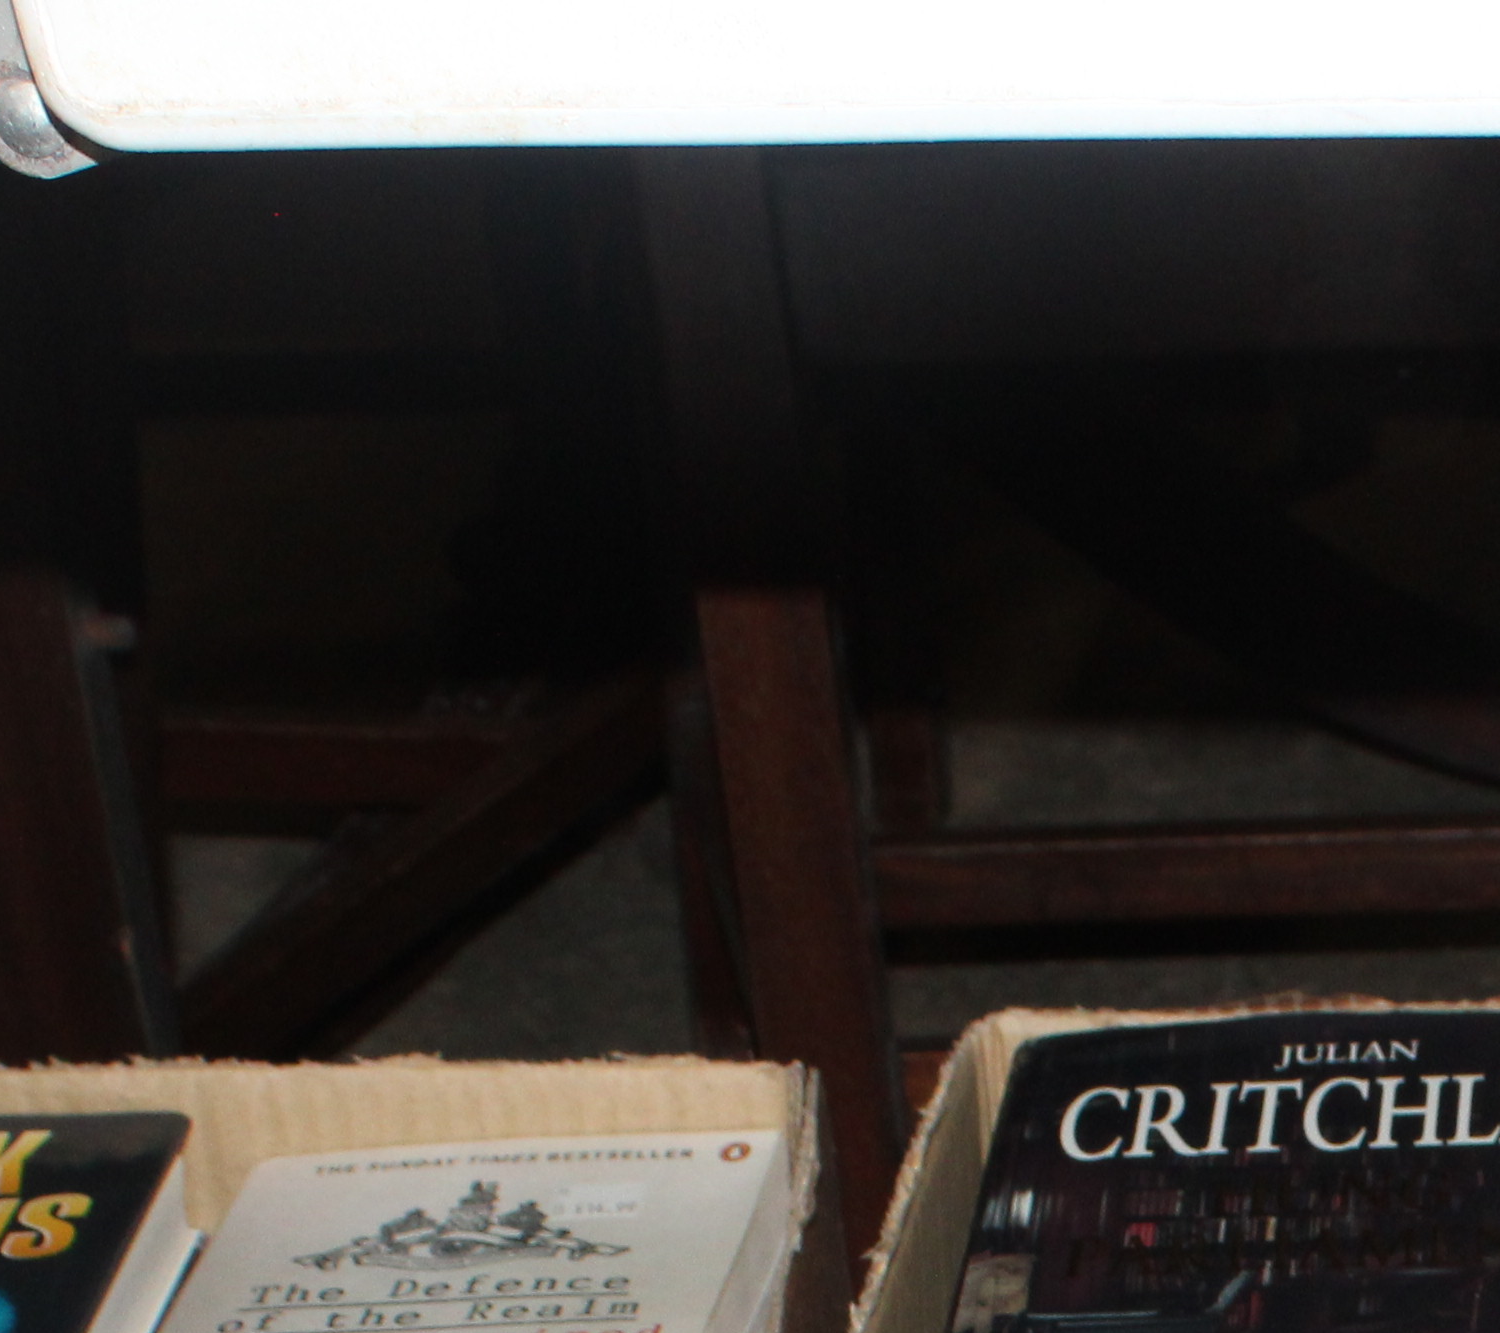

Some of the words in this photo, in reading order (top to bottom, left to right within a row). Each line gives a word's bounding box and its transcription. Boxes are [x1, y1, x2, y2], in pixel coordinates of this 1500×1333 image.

[1274, 1040, 1420, 1071] JULIAN
[250, 1284, 346, 1305] The
[389, 1274, 632, 1299] Defence
[326, 1305, 422, 1330] the
[466, 1299, 641, 1321] Realm
